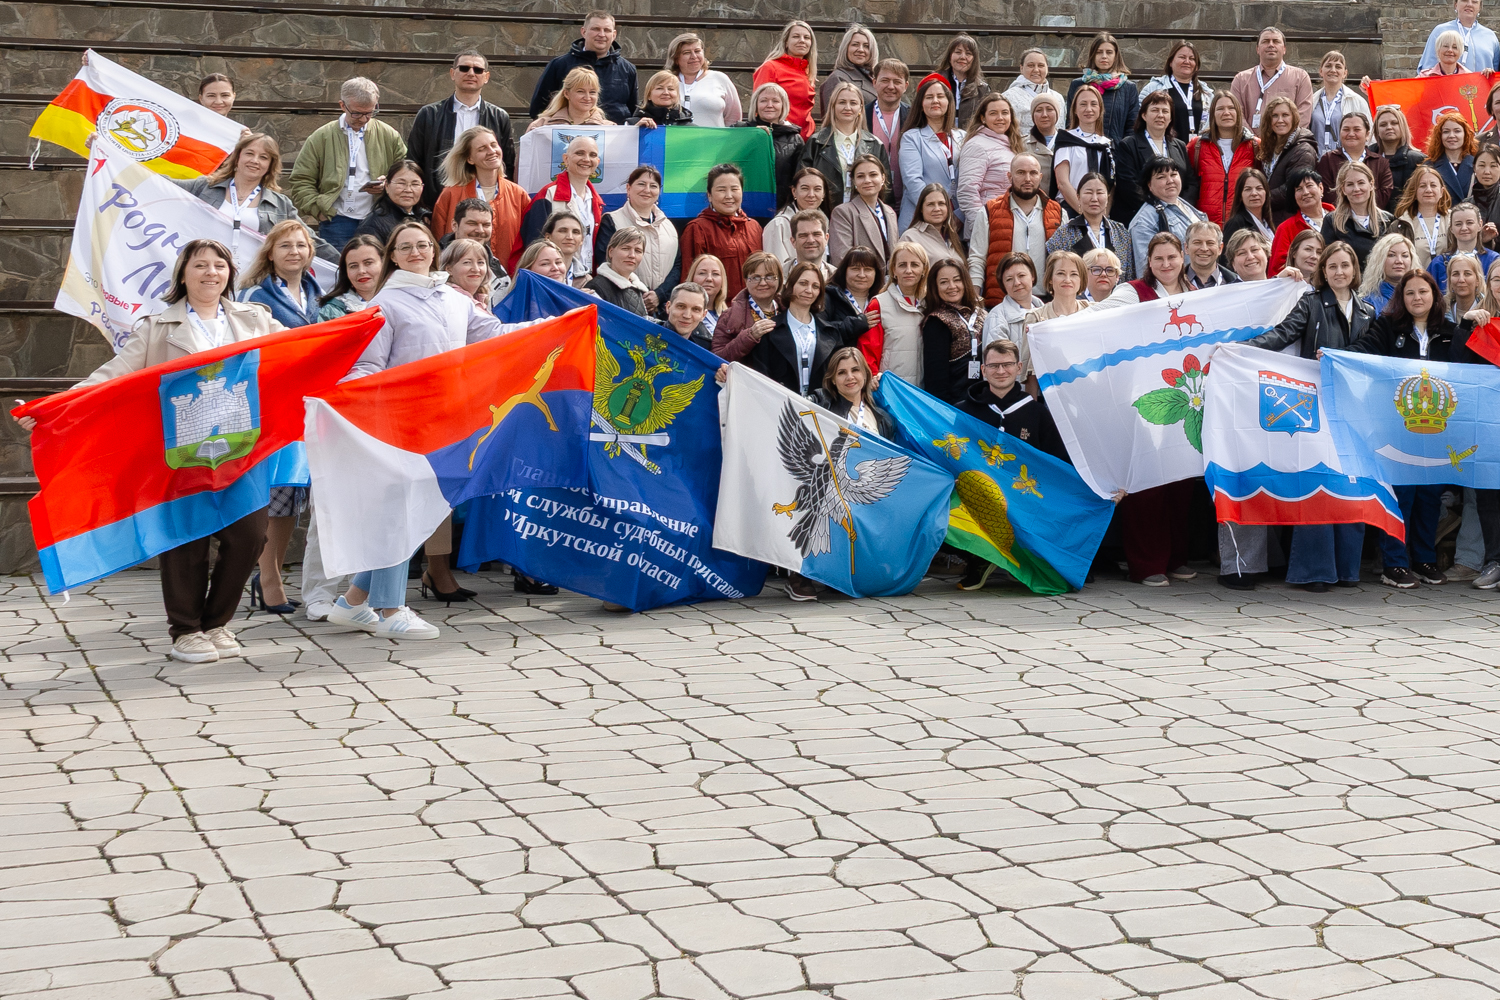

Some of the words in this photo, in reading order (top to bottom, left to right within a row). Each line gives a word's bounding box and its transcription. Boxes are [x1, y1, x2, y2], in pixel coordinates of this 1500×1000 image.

[98, 182, 186, 257] Родн
[84, 271, 99, 289] Это
[511, 511, 624, 563] Иркутской
[525, 494, 611, 531] службы
[613, 520, 689, 564] судебных
[592, 491, 700, 539] управление
